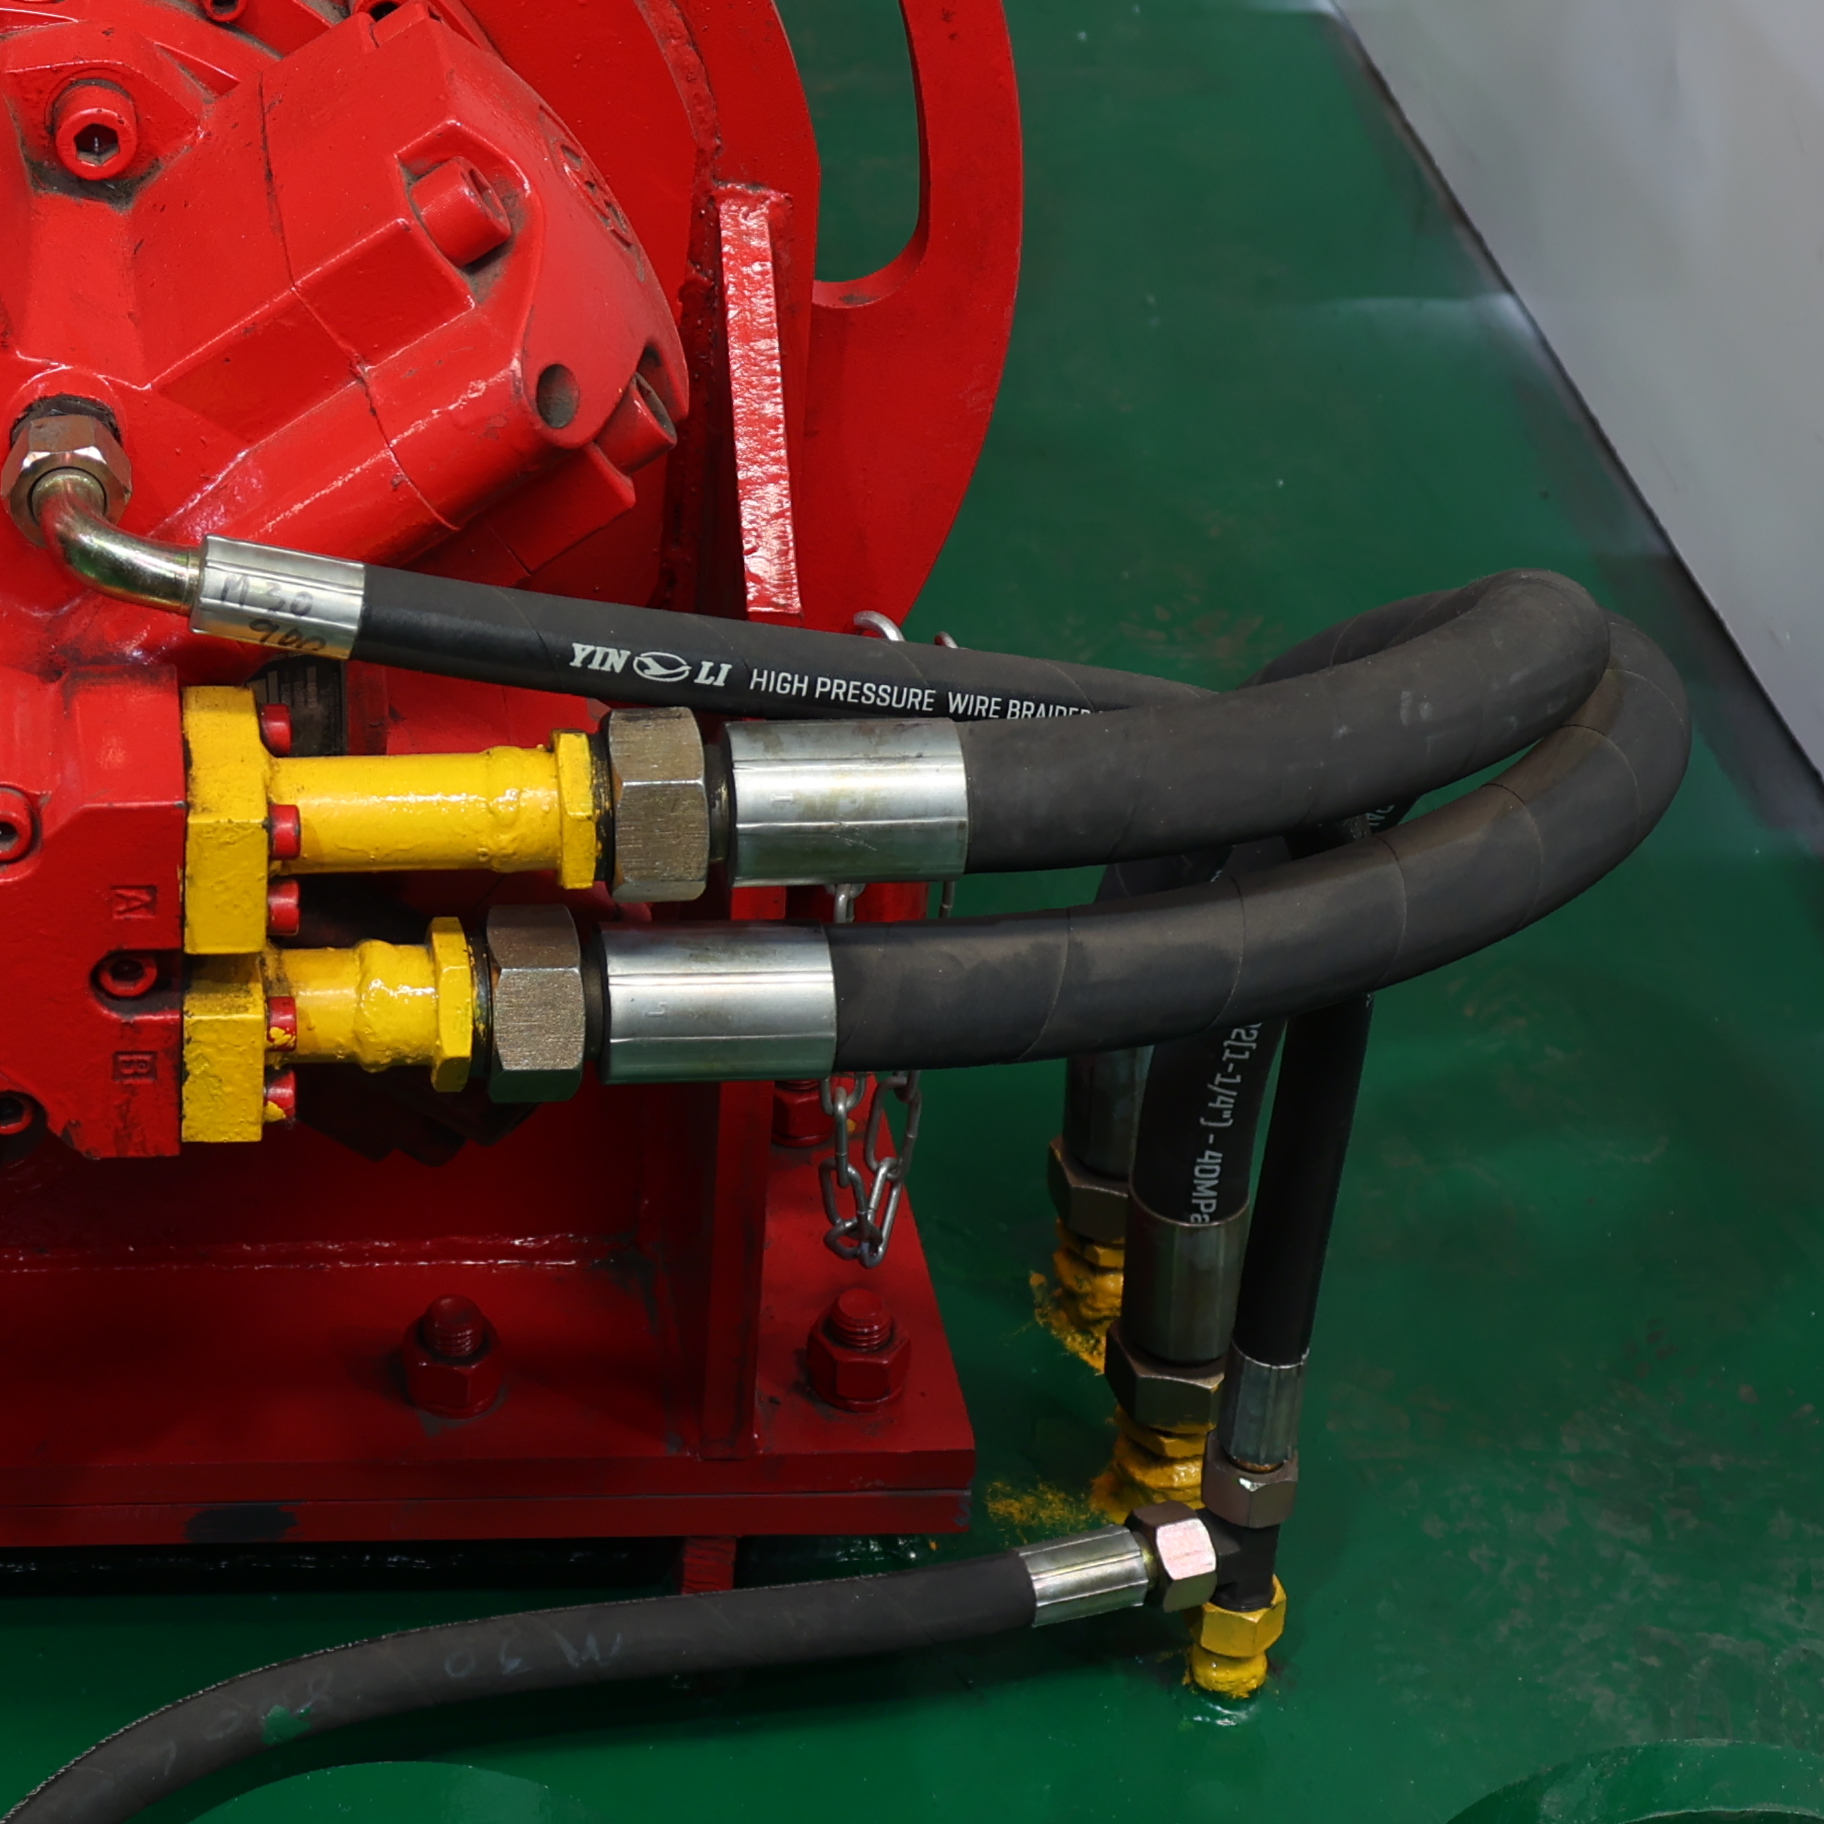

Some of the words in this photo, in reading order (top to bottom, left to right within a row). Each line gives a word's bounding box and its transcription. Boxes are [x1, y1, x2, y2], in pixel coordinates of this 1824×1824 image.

[569, 643, 631, 674] YIN
[693, 661, 732, 687] LI
[749, 668, 809, 697] HIGH
[814, 677, 937, 712] PRESSURE
[947, 691, 1003, 720] WIRE
[1006, 699, 1092, 720] BRAID
[113, 887, 156, 916] A
[114, 1052, 155, 1078] B
[1190, 1149, 1224, 1225] 40MPa
